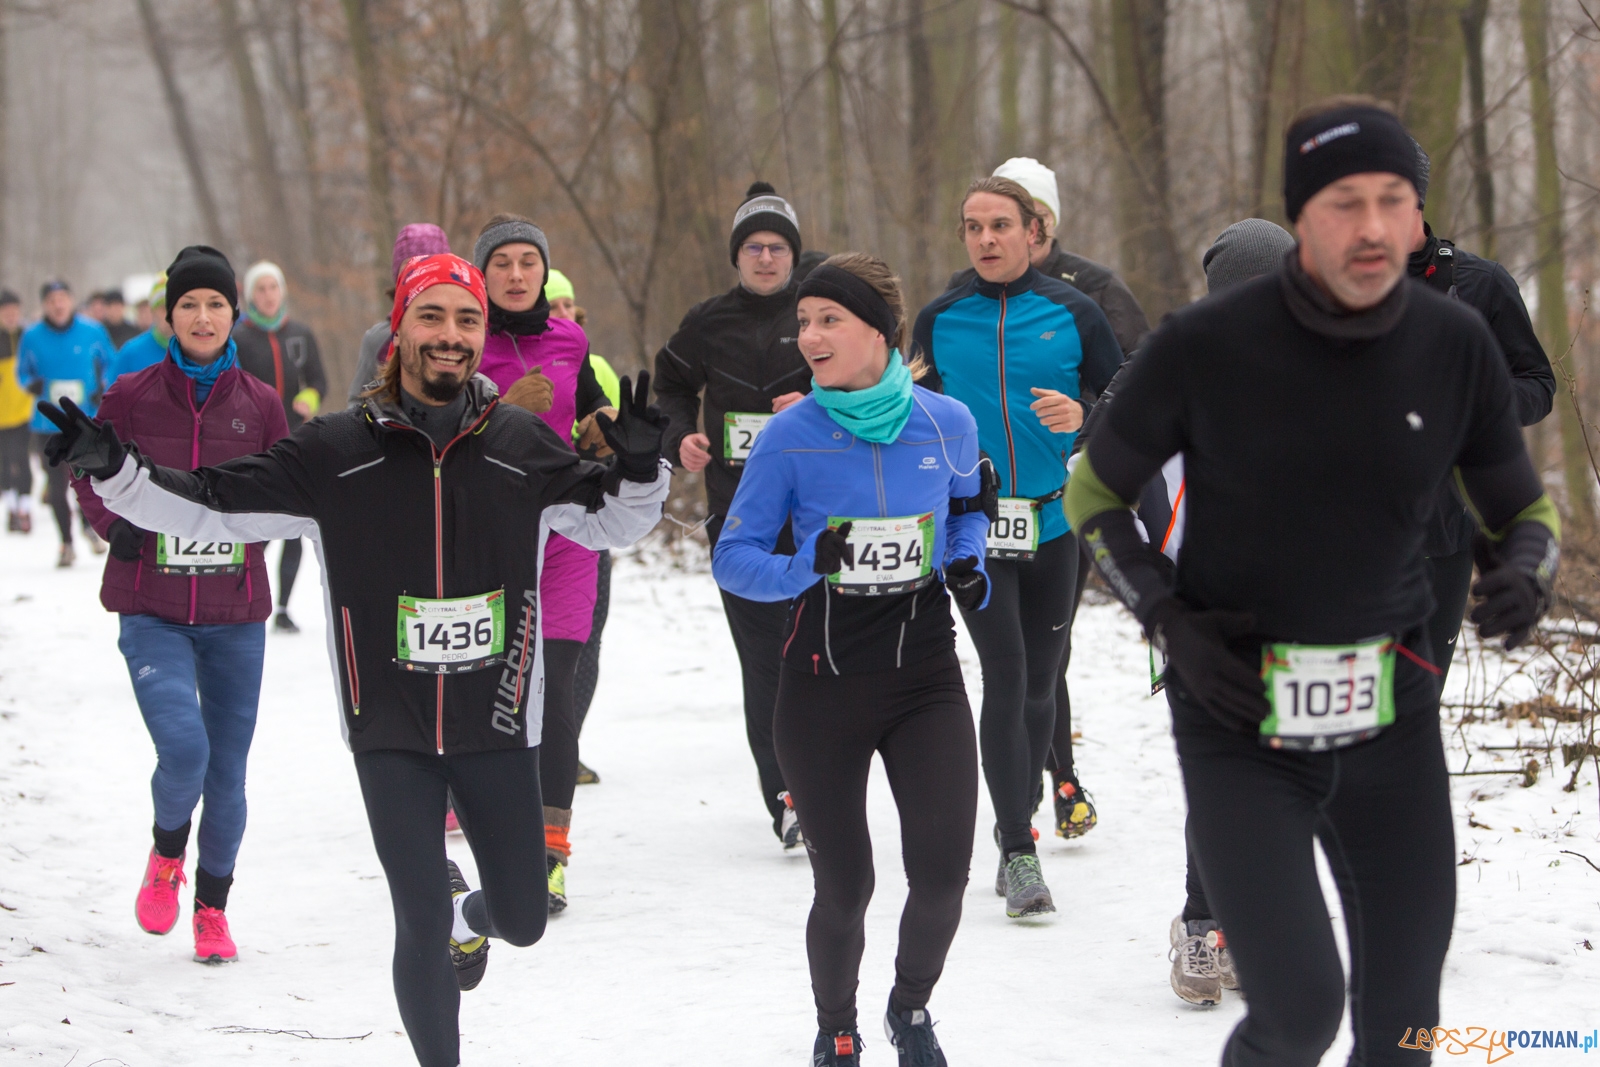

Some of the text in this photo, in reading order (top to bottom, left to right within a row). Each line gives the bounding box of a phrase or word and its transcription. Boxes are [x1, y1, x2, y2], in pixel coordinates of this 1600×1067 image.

[191, 557, 213, 565] IWONA
[845, 539, 922, 571] 1434
[876, 574, 894, 582] EWA
[413, 617, 491, 650] 1436
[441, 652, 468, 662] PEDRO
[1286, 677, 1375, 717] 1033
